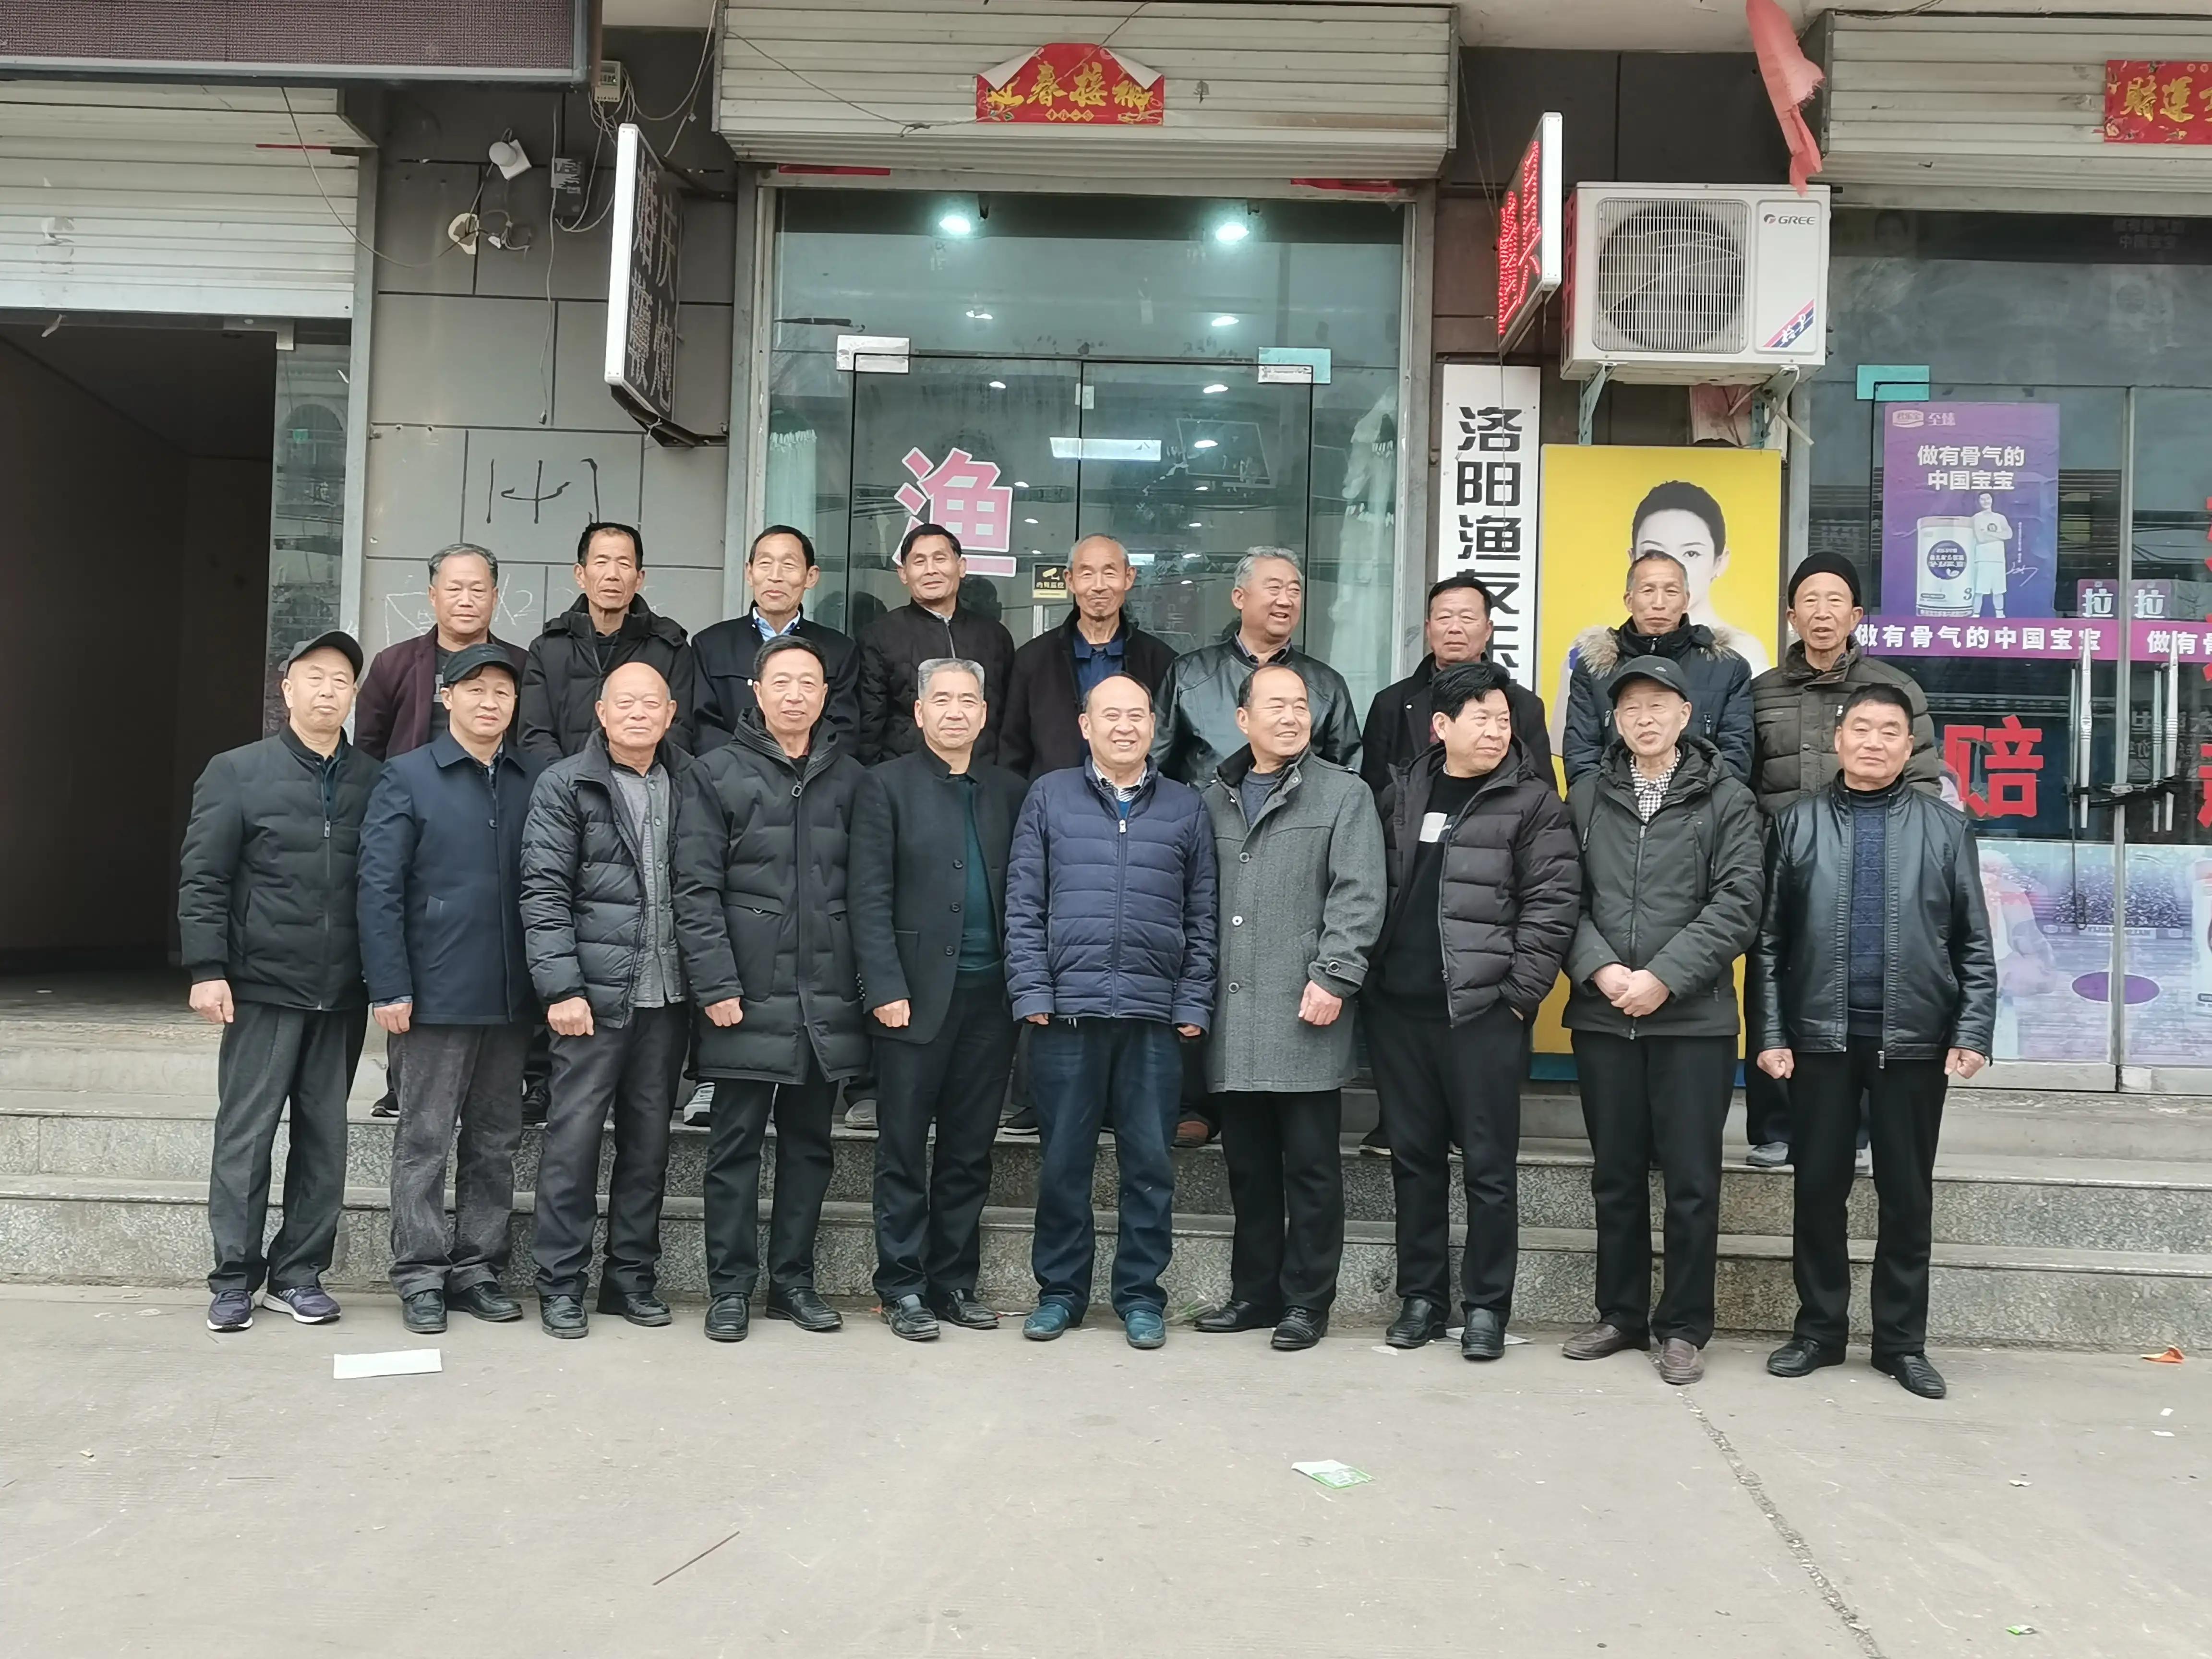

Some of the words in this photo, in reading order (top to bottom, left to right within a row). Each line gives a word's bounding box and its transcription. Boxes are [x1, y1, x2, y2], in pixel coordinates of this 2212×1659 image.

[1778, 216, 1816, 225] GREE
[1917, 445, 2025, 467] 做有骨气的
[1928, 469, 2015, 490] 中国宝宝
[1456, 407, 1522, 684] 洛阳渔友
[2082, 589, 2114, 617] 拉
[2134, 589, 2165, 618] 拉
[1854, 624, 2101, 651] 做有骨气的中国宝宝
